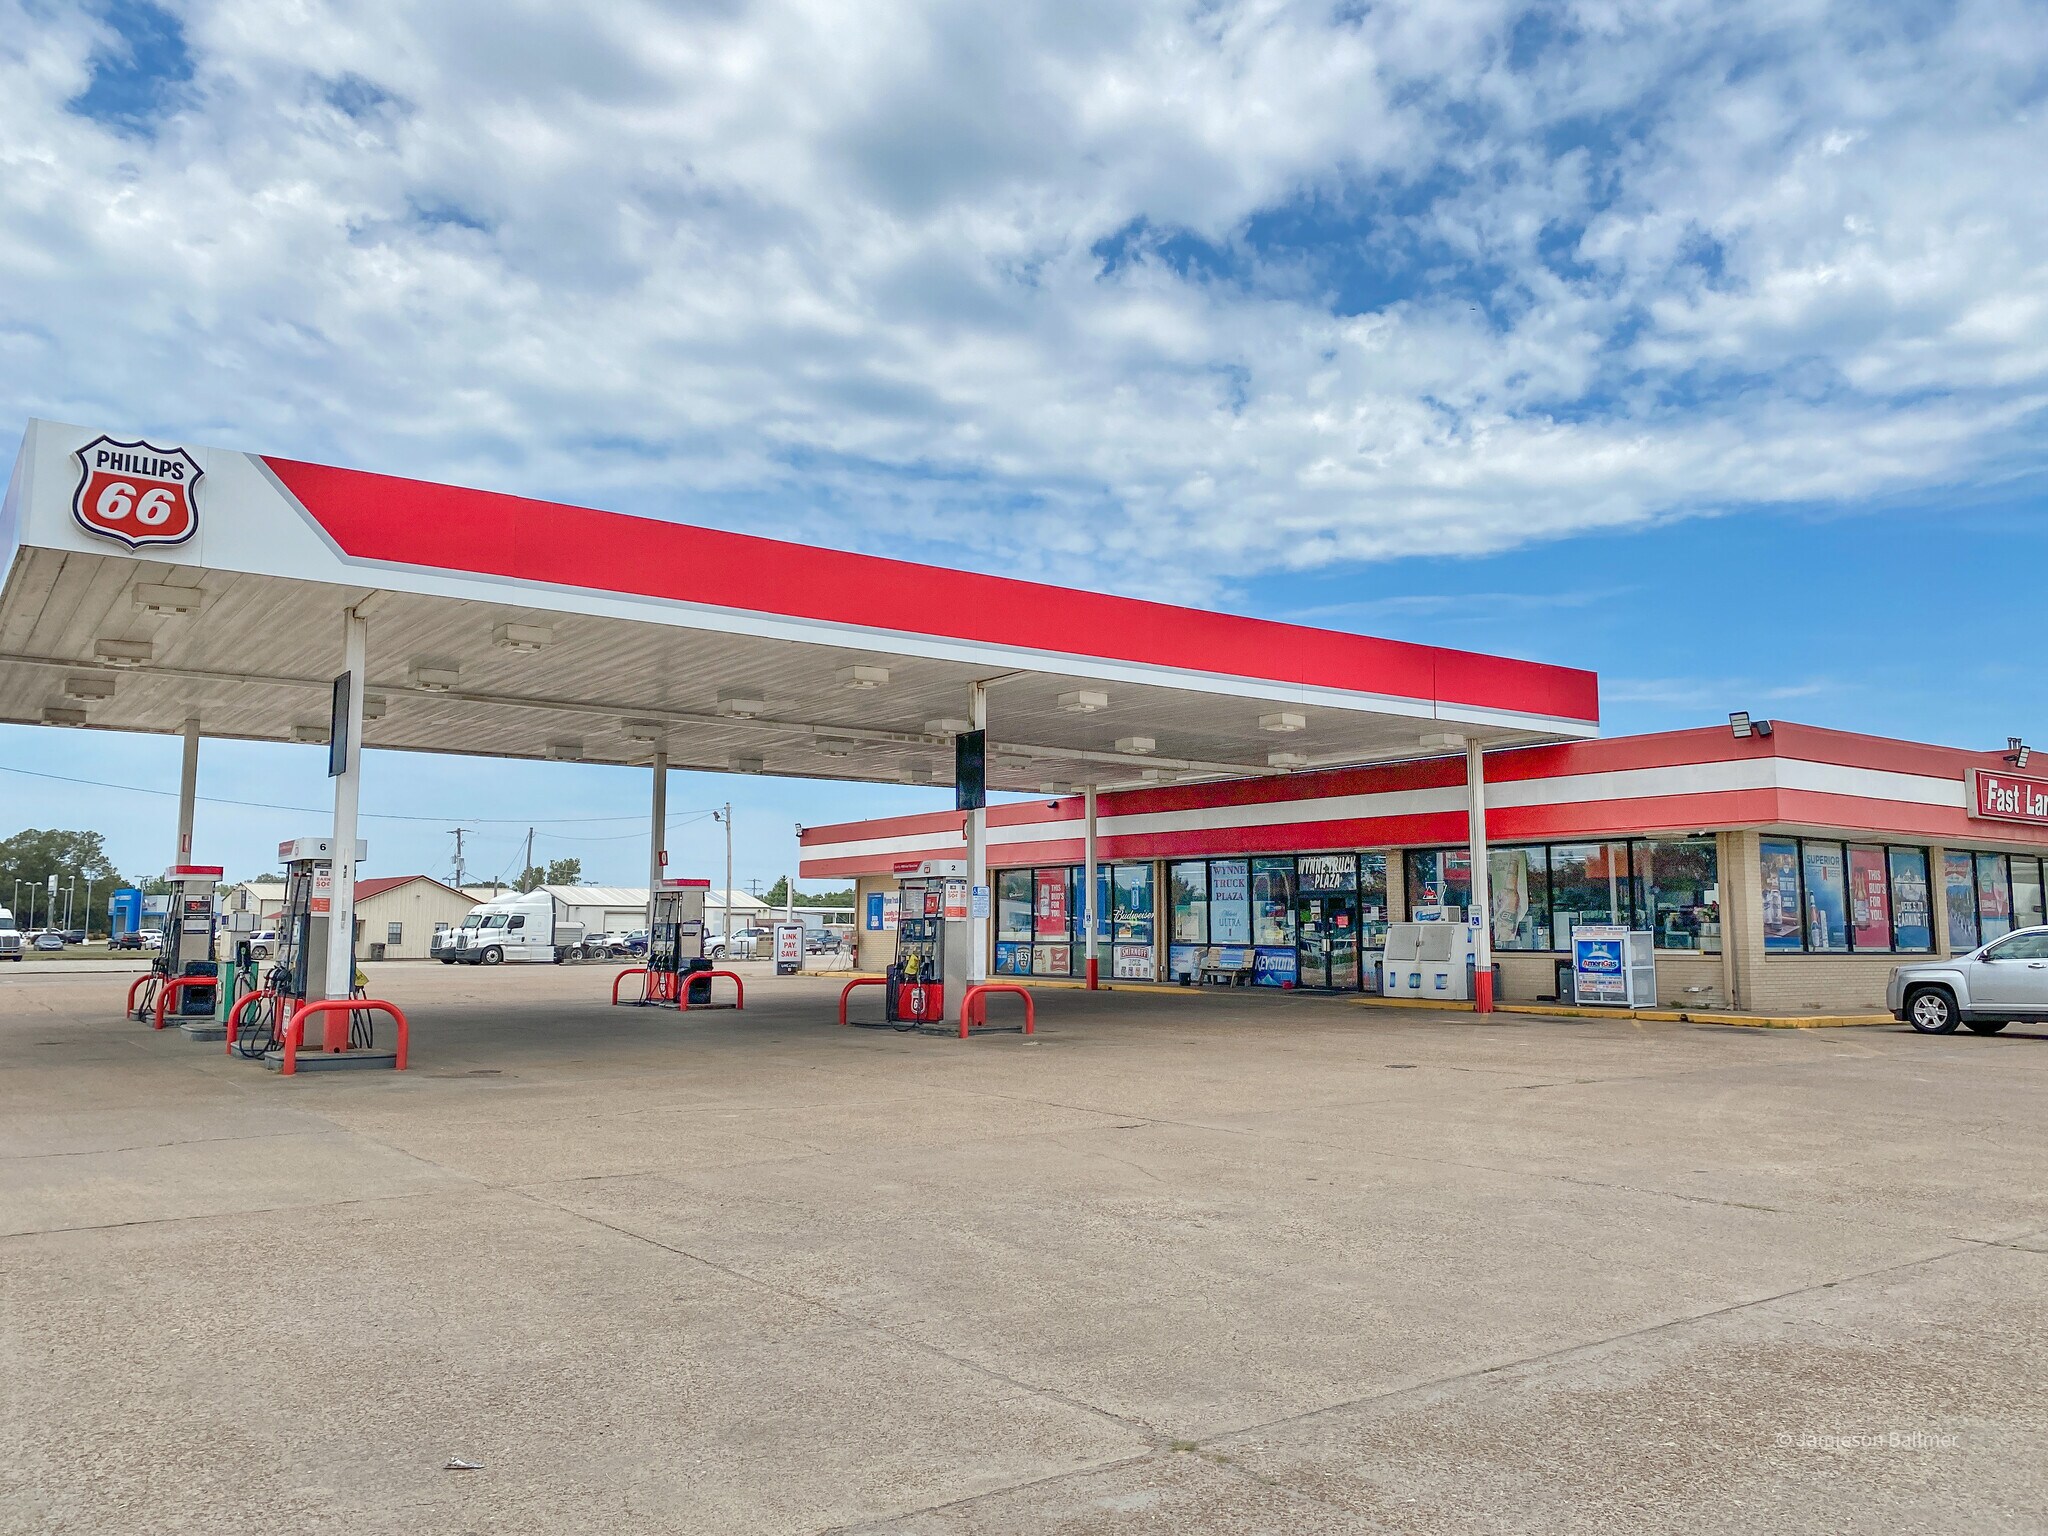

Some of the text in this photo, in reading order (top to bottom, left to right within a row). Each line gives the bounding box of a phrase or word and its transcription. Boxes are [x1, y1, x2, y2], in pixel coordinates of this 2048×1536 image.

[96, 449, 185, 480] PHILLIPS
[96, 482, 176, 526] 66
[1987, 779, 2020, 814] Fast
[319, 843, 327, 851] 6
[1298, 856, 1357, 875] WYNNE TRUCK
[1806, 854, 1840, 866] SUPERIOR
[1212, 866, 1246, 875] WYNNE
[1867, 869, 1881, 881] THIS
[1213, 879, 1246, 888] TRUCK
[1314, 873, 1340, 889] PLAZA
[1051, 884, 1061, 892] THIS
[1868, 883, 1887, 894] BUD'S
[1051, 892, 1065, 900] BUD'S
[1215, 892, 1244, 901] PLAZA
[1869, 896, 1881, 907] FOR
[1051, 901, 1060, 909] FOR
[1113, 909, 1155, 921] Budweiser
[1219, 918, 1241, 927] ULTRA
[1121, 947, 1148, 958] SMIRNOFF
[1582, 959, 1618, 967] AmeriGas
